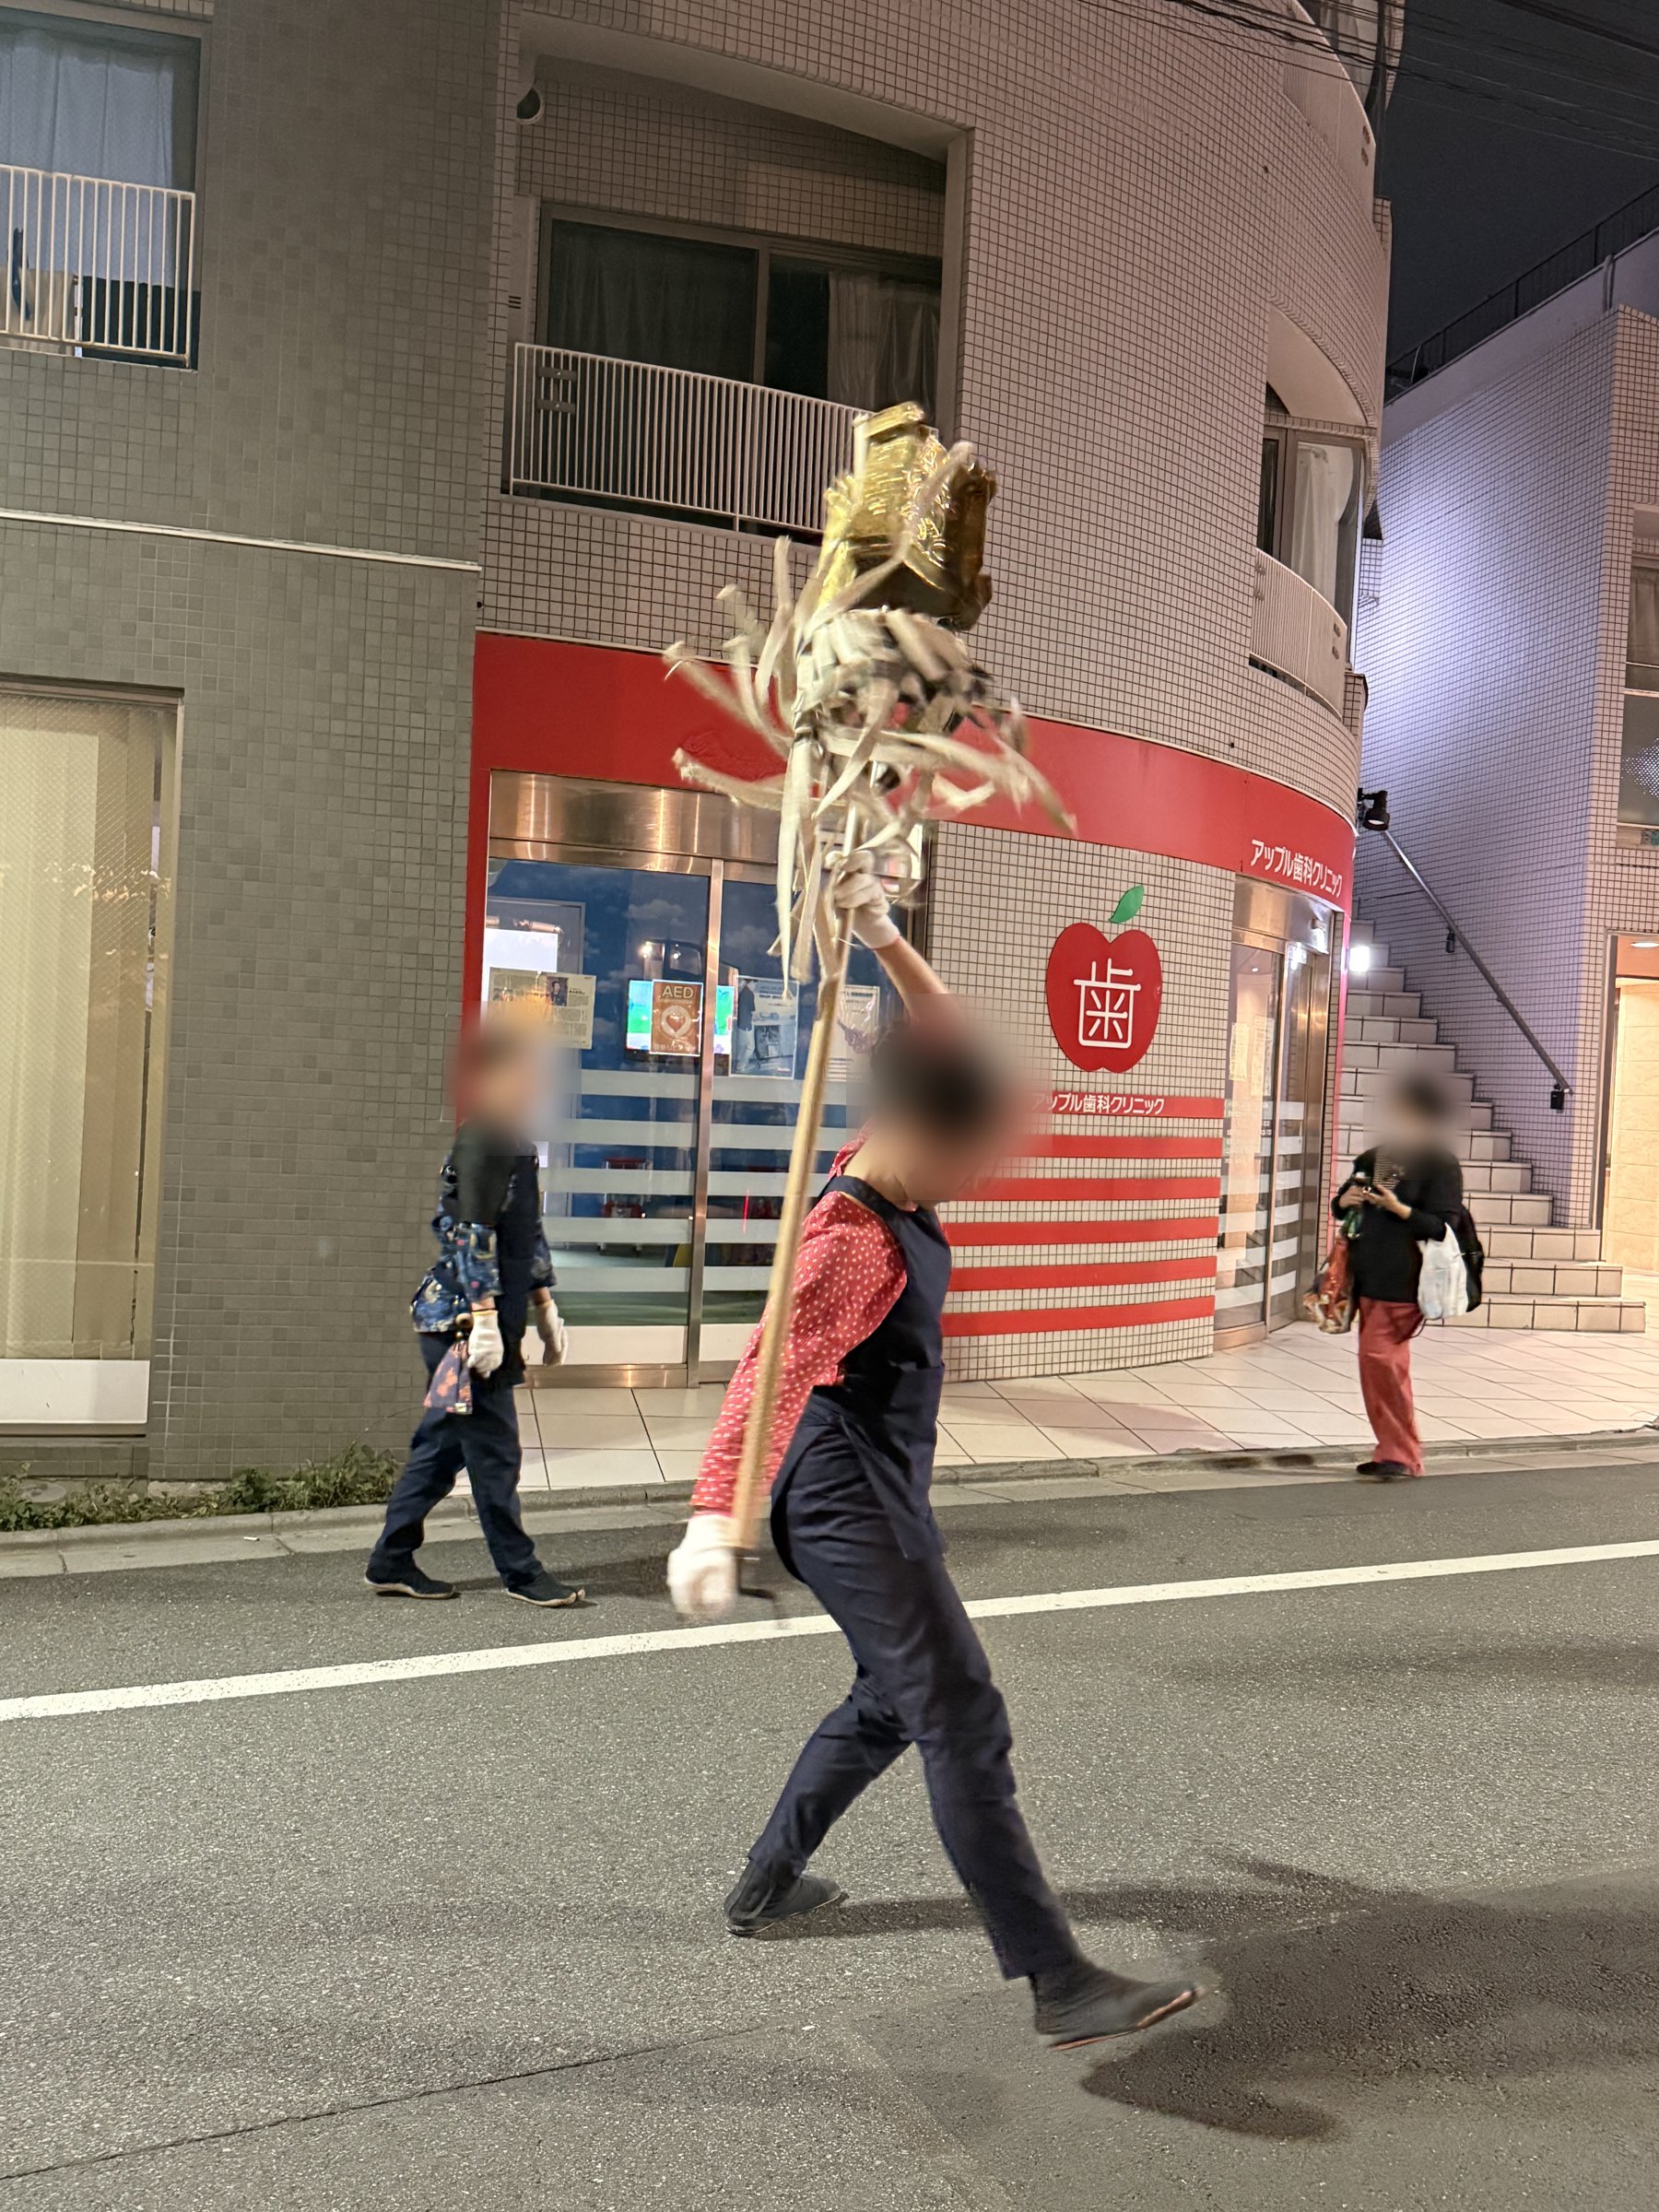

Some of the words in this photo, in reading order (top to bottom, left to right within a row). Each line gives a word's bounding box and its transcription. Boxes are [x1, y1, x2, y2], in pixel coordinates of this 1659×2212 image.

[1250, 839, 1343, 899] アップル歯科クリニック
[662, 985, 694, 999] AED
[1073, 958, 1142, 1050] 歯
